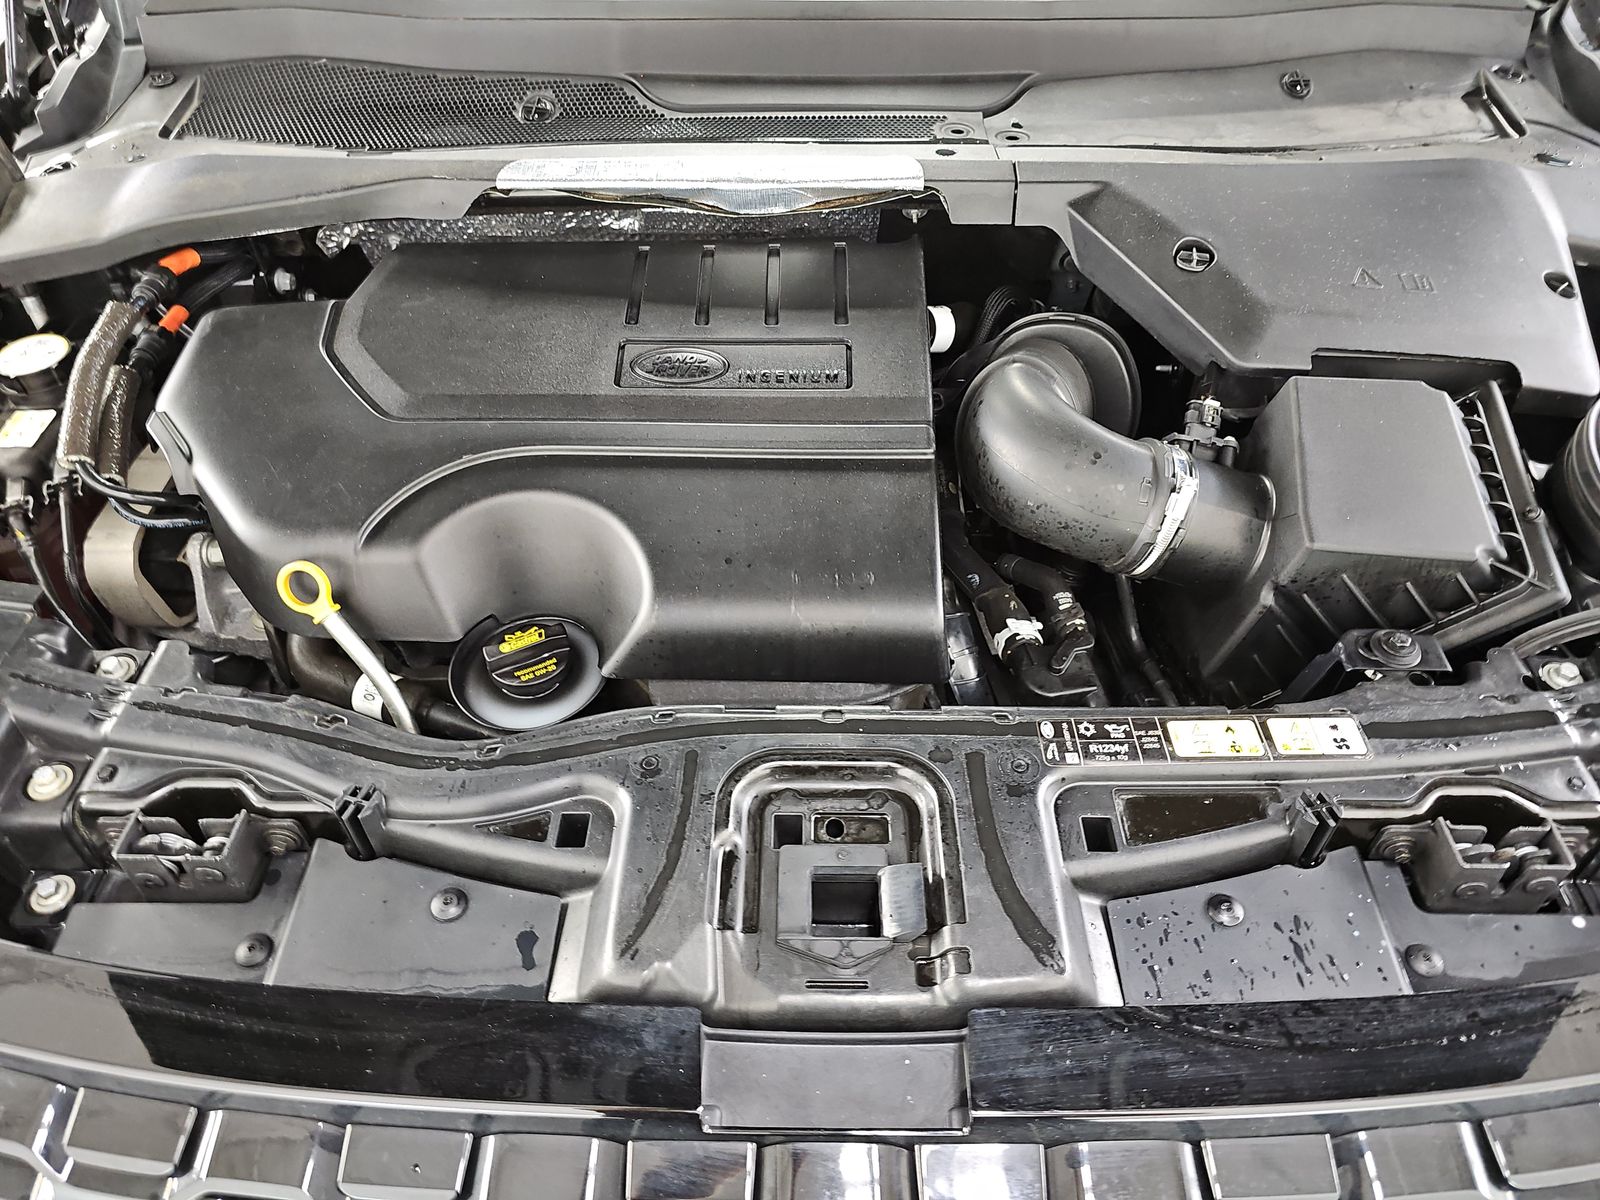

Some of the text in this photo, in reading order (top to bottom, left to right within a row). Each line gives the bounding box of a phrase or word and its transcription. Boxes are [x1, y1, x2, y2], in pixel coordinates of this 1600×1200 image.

[652, 354, 709, 366] LAND
[649, 364, 711, 378] ROVER
[737, 369, 841, 384] INGENIUM
[514, 657, 558, 677] recommended
[520, 664, 557, 682] SAE 0W-20
[1089, 743, 1129, 755] R1234yf
